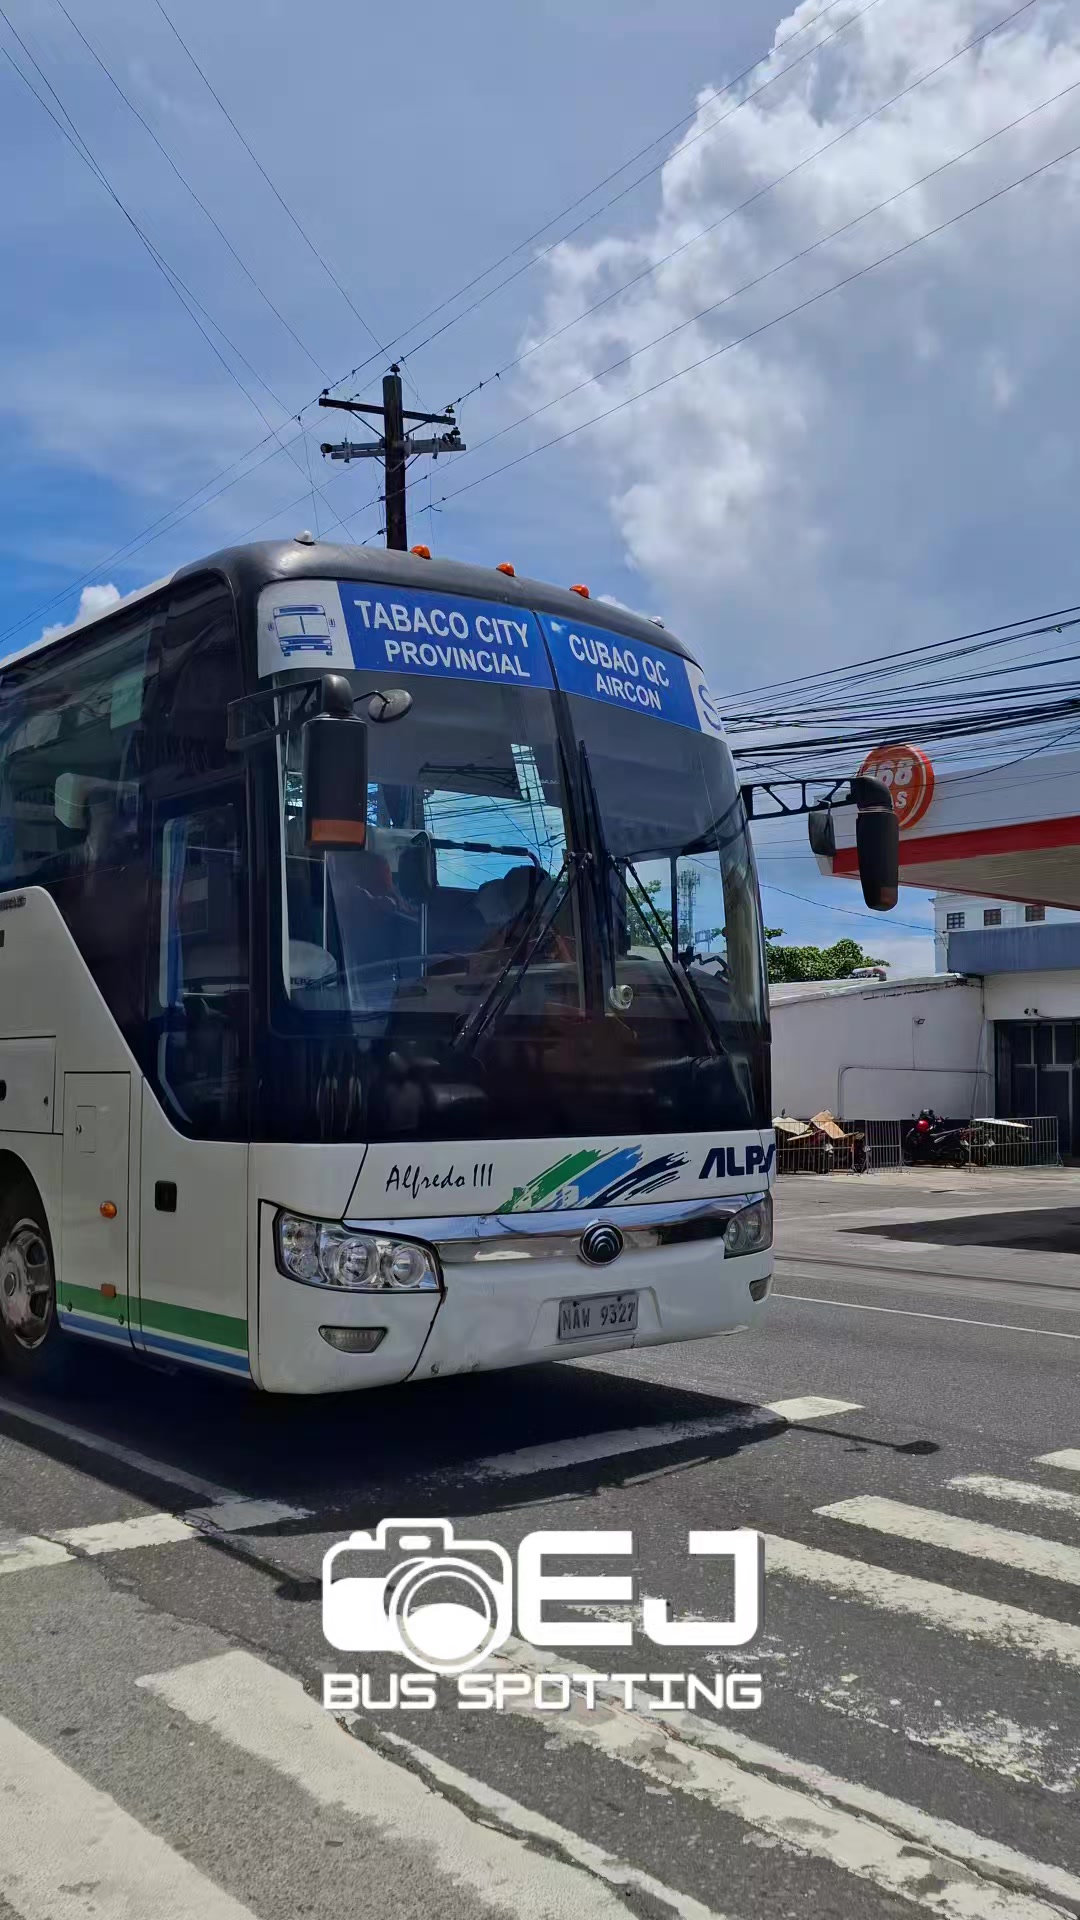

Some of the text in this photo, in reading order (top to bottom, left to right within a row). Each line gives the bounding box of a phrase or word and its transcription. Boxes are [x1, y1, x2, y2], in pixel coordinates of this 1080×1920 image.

[353, 600, 529, 648] TABACO CITY
[384, 639, 531, 678] PROVINCIAL
[568, 633, 670, 687] CUBAO QC
[596, 672, 662, 711] AIRCON
[385, 1164, 466, 1200] Alfredo
[562, 1301, 636, 1331] NAW 9327
